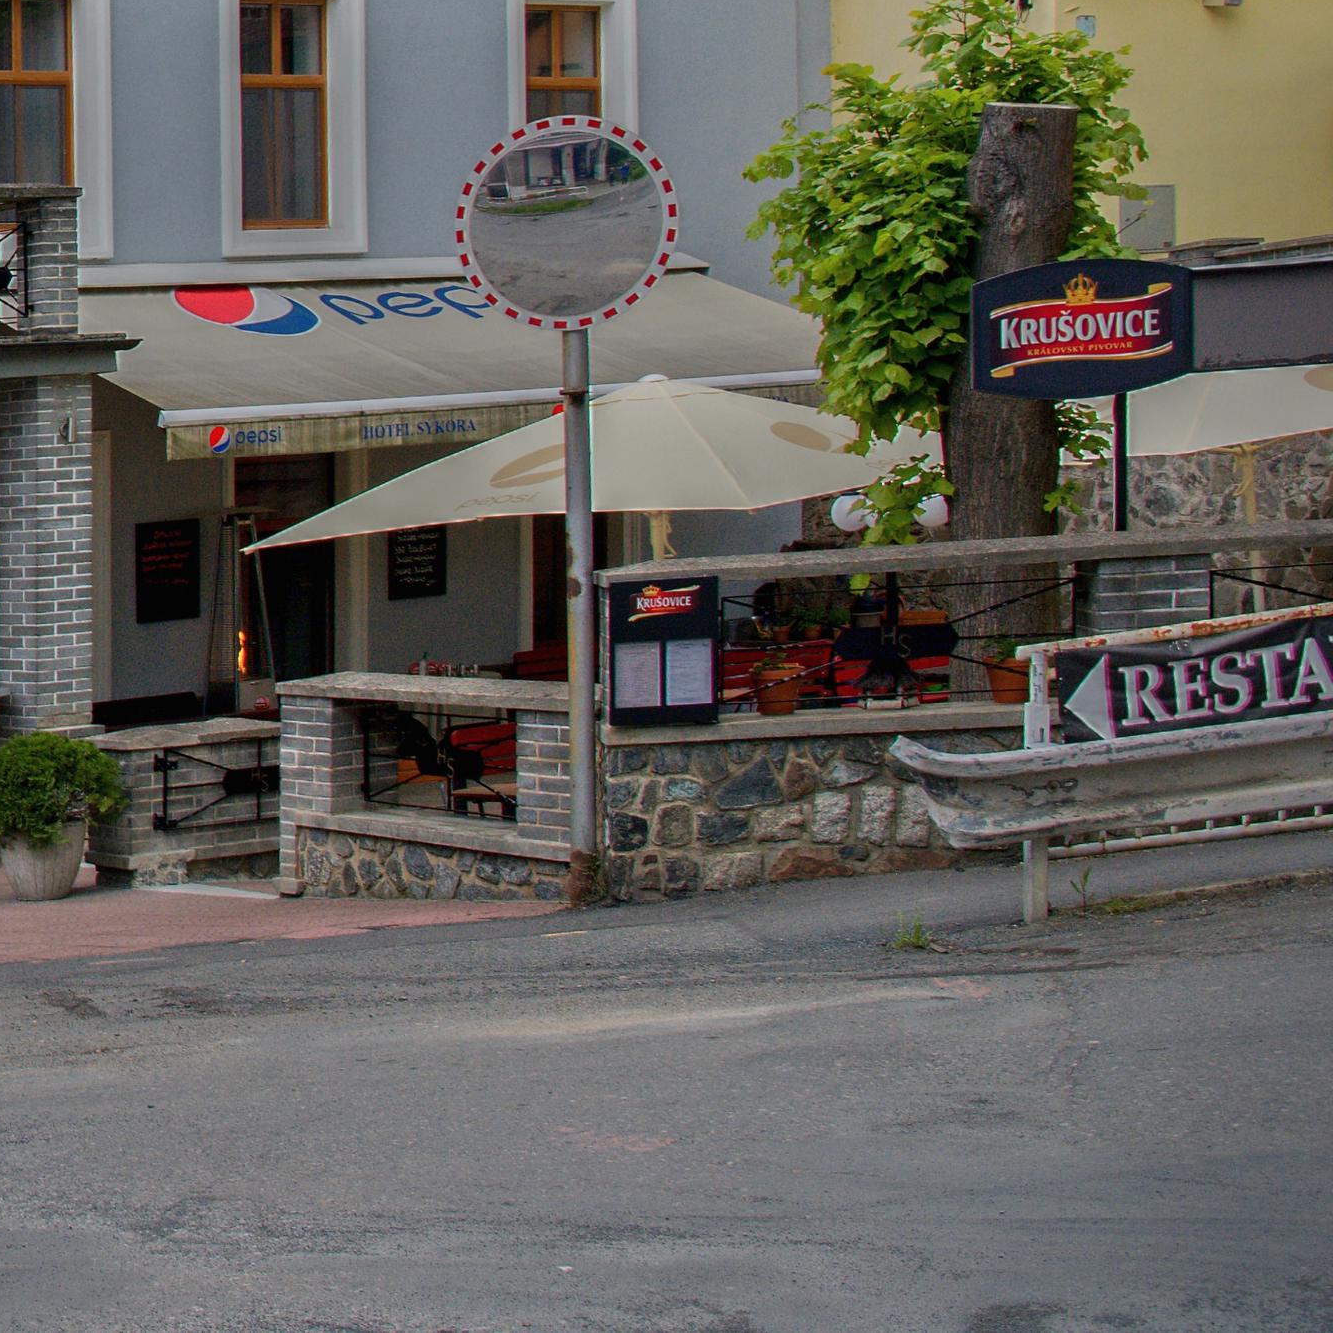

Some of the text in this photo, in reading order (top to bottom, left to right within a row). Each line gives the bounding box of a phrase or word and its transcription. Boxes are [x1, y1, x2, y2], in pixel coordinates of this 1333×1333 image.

[319, 285, 492, 326] pep
[1000, 309, 1161, 350] KRUŠOVICE
[1027, 341, 1134, 356] KRÁLOVSKÝ PIVOVAR
[235, 426, 282, 447] pepsi
[363, 423, 410, 439] HOTEL
[455, 491, 541, 512] pepsi
[636, 595, 692, 612] KRUŠOVICE
[1118, 635, 1333, 726] RESTA
